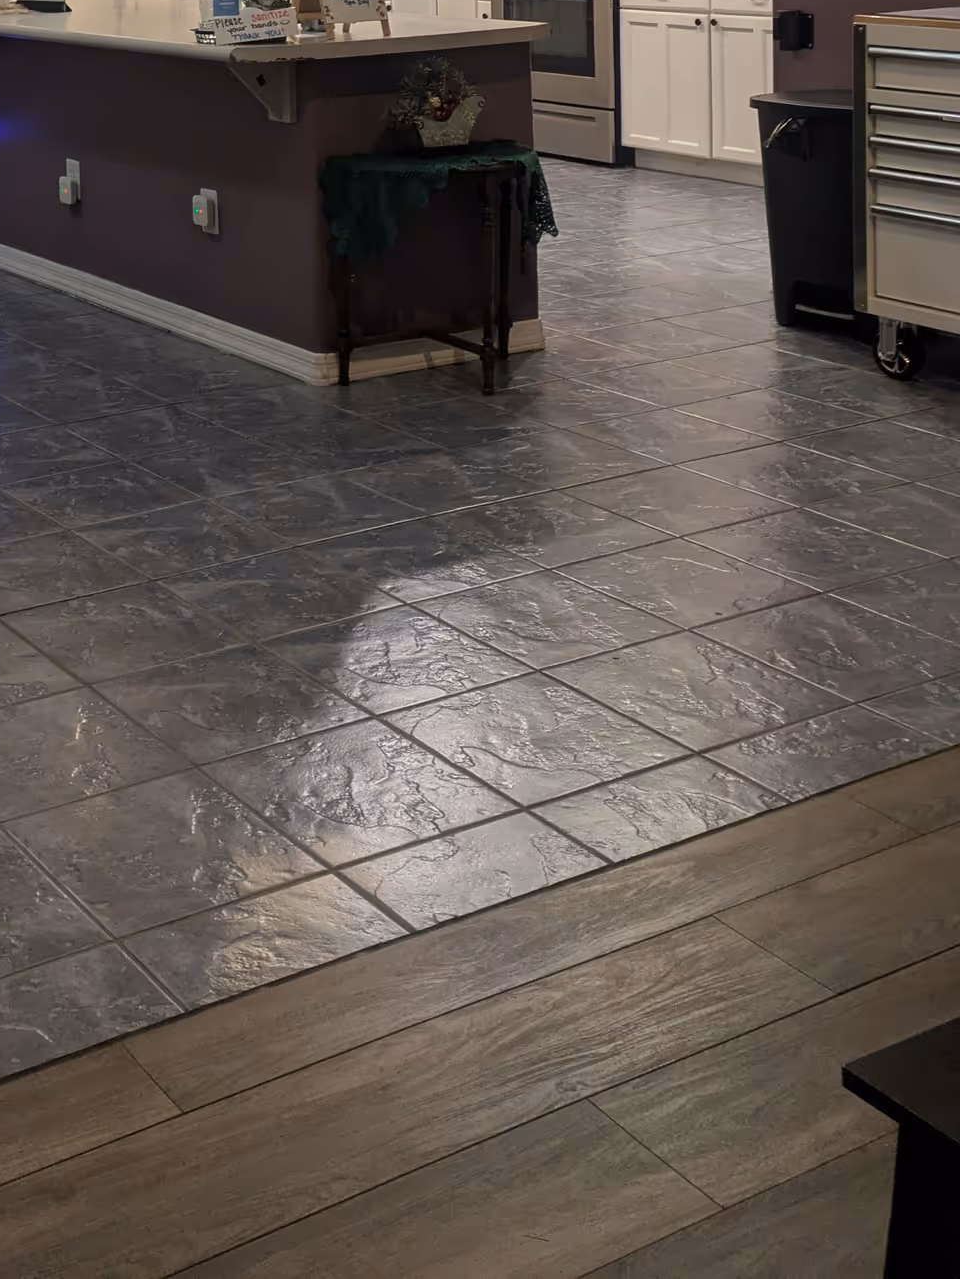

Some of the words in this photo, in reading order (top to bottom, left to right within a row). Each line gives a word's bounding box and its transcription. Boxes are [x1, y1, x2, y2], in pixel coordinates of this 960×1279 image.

[358, 0, 370, 7] Day
[227, 25, 247, 34] your
[250, 20, 278, 29] hands
[232, 31, 260, 40] THANK
[265, 28, 285, 38] YOU!
